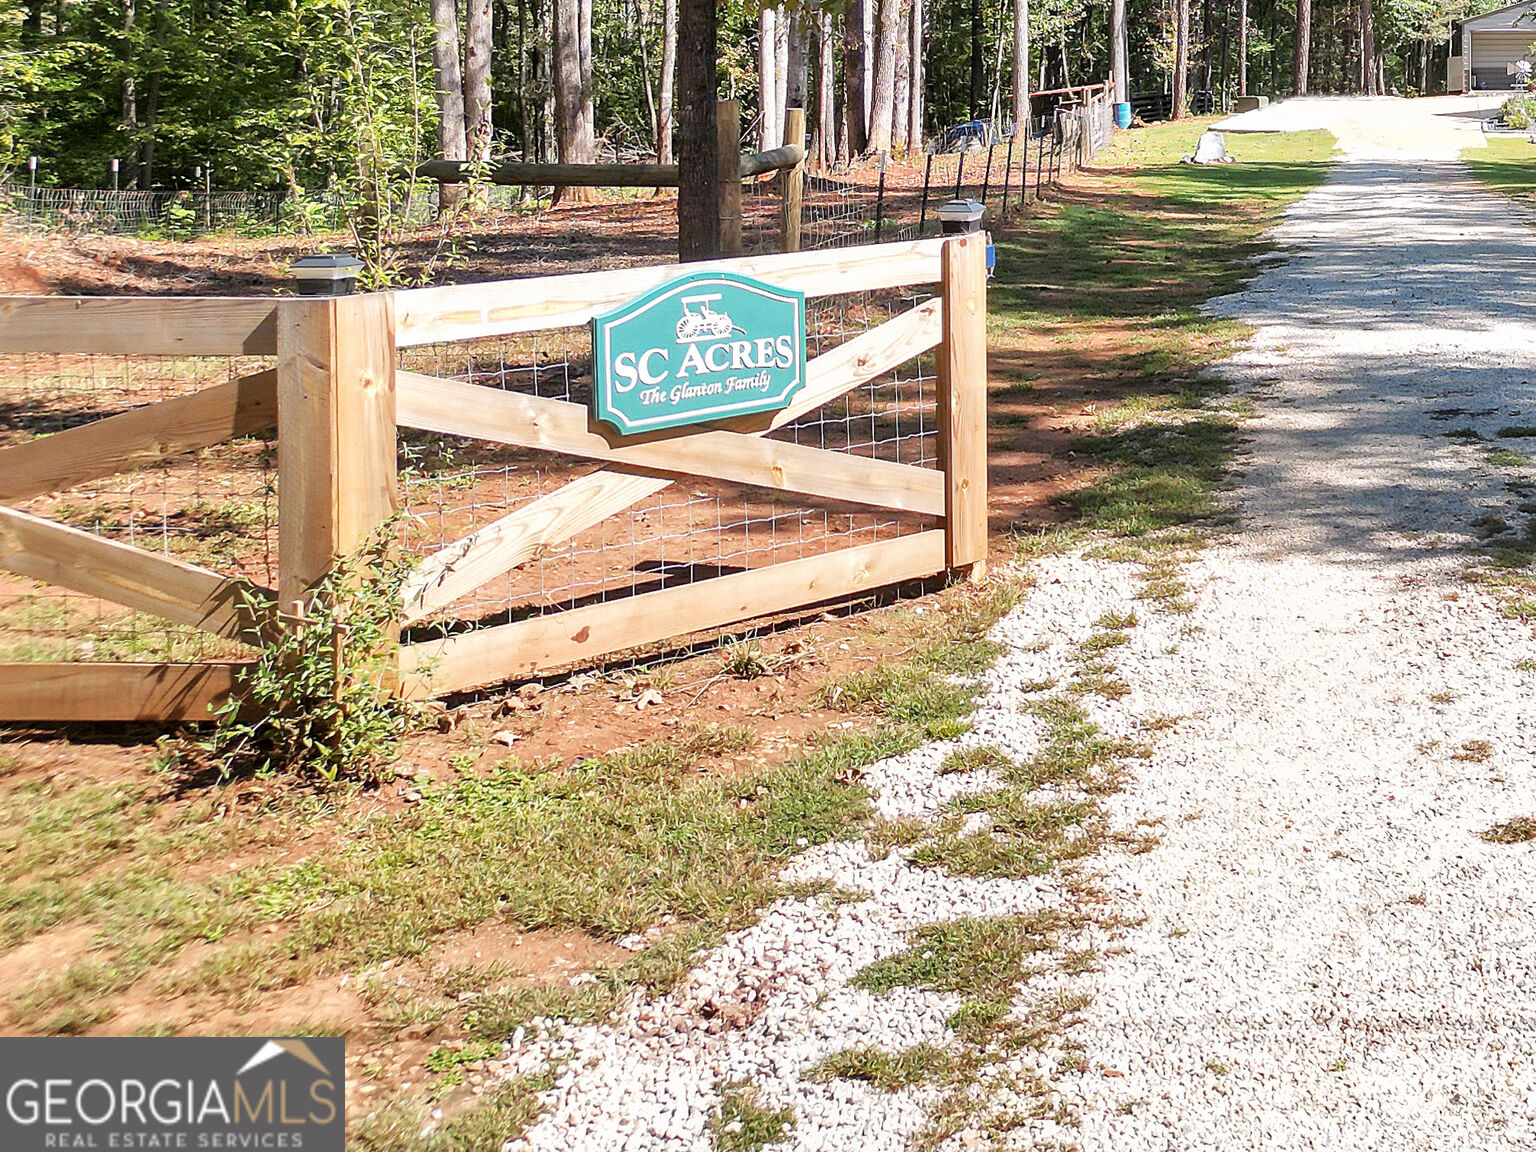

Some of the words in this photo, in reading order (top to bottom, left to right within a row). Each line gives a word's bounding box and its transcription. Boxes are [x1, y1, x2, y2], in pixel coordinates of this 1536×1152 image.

[614, 348, 669, 394] SC
[676, 335, 793, 378] ACRES
[639, 386, 667, 406] The
[669, 378, 723, 405] Glanton
[724, 369, 772, 394] Family
